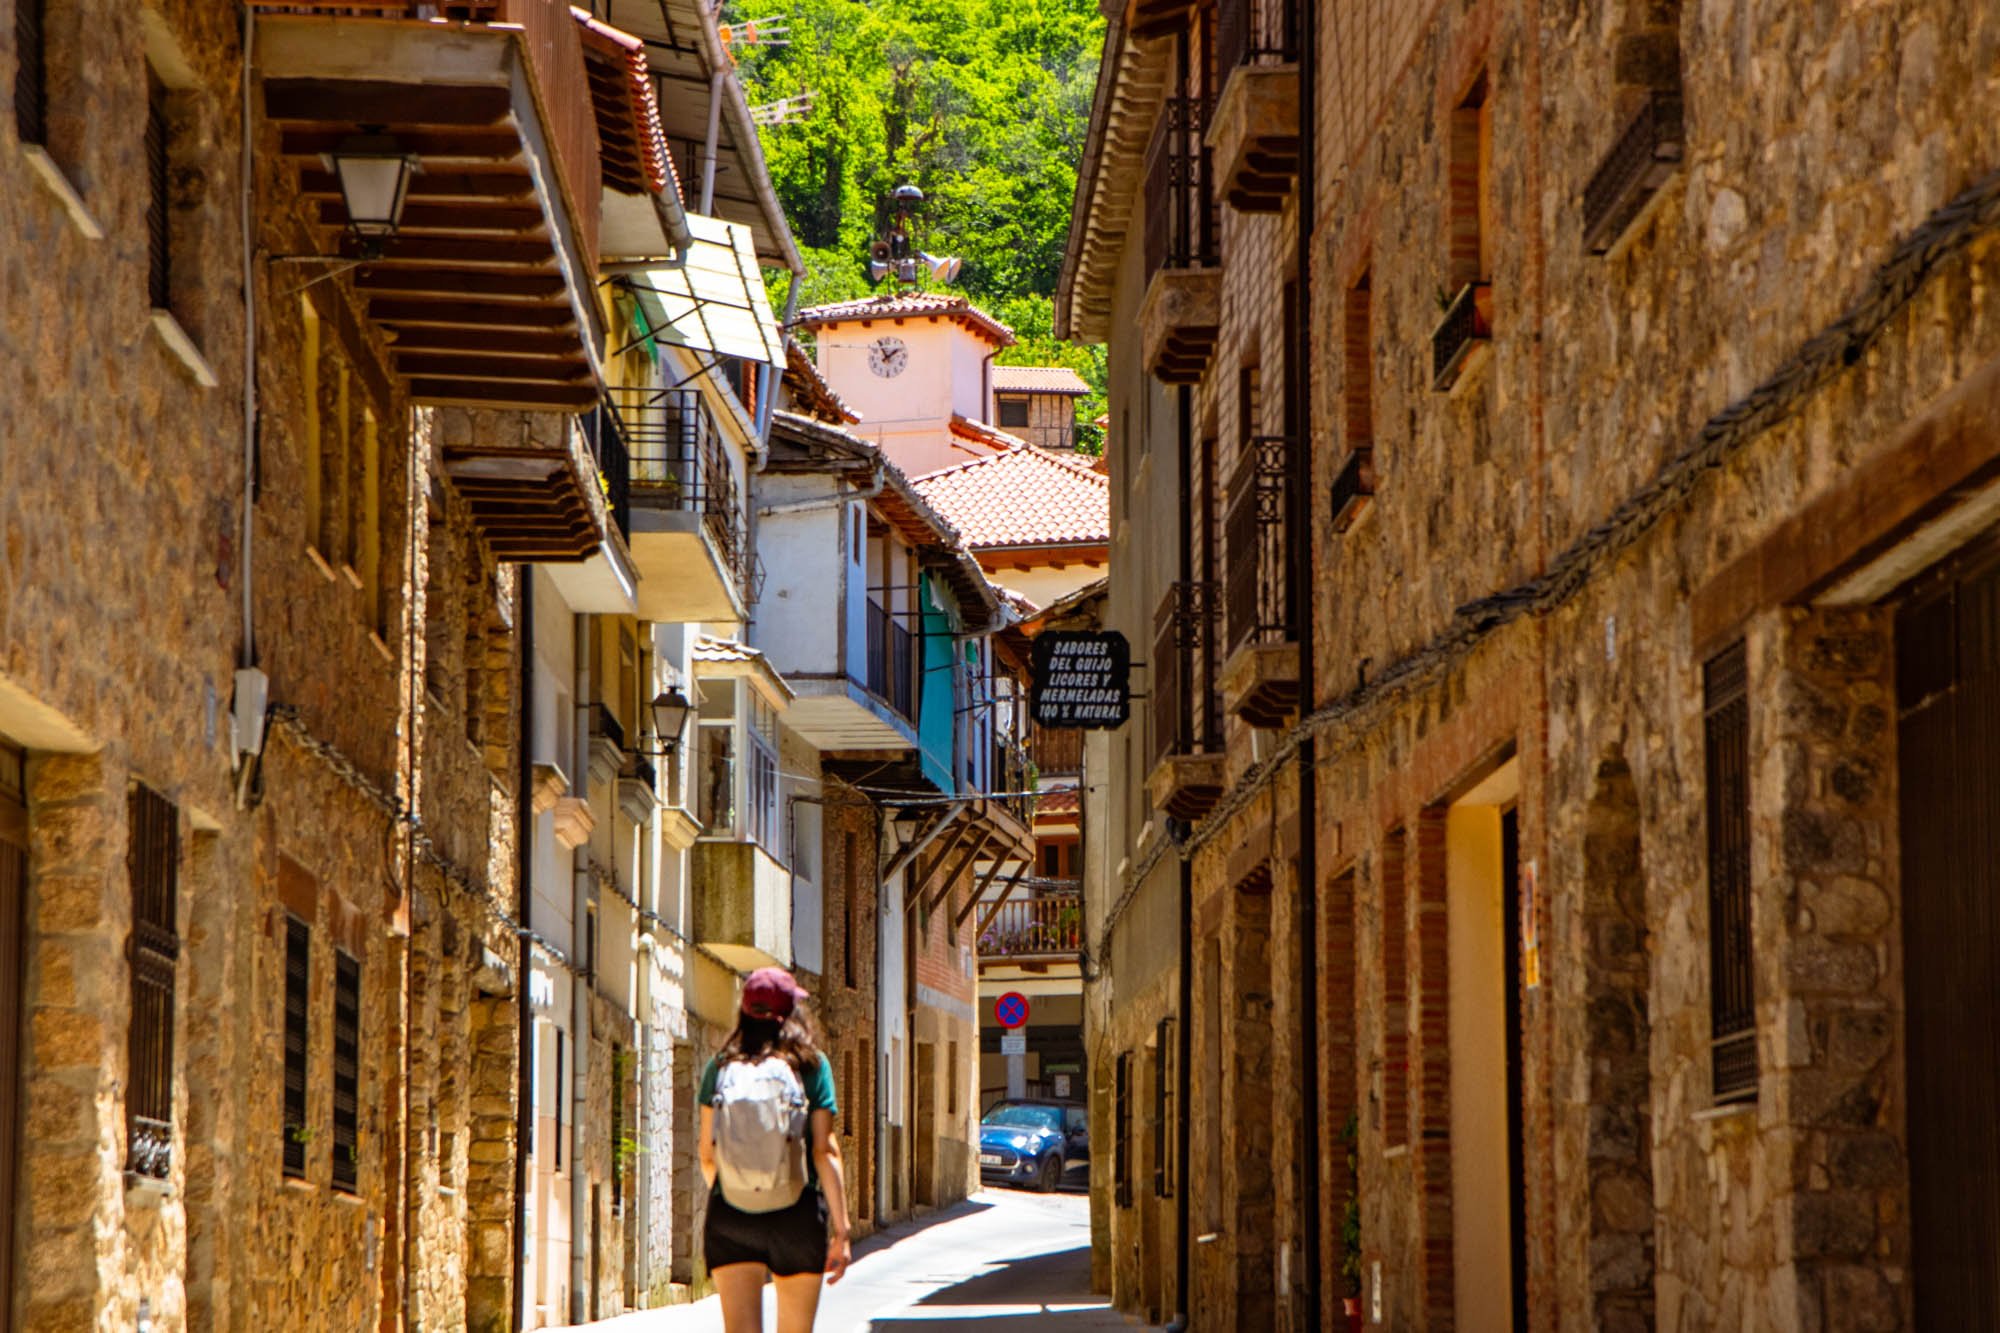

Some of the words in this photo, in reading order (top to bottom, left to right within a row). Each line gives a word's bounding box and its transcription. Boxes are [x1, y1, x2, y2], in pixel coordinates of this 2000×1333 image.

[1053, 641, 1108, 655] SABORES
[1049, 657, 1071, 671] DEL
[1075, 657, 1113, 671] GUIJO
[1049, 673, 1099, 687] LICORES
[1102, 673, 1112, 687] Y
[1040, 689, 1121, 703] MERMELADAS
[1039, 705, 1058, 718] 100
[1074, 705, 1121, 719] NATURAL
